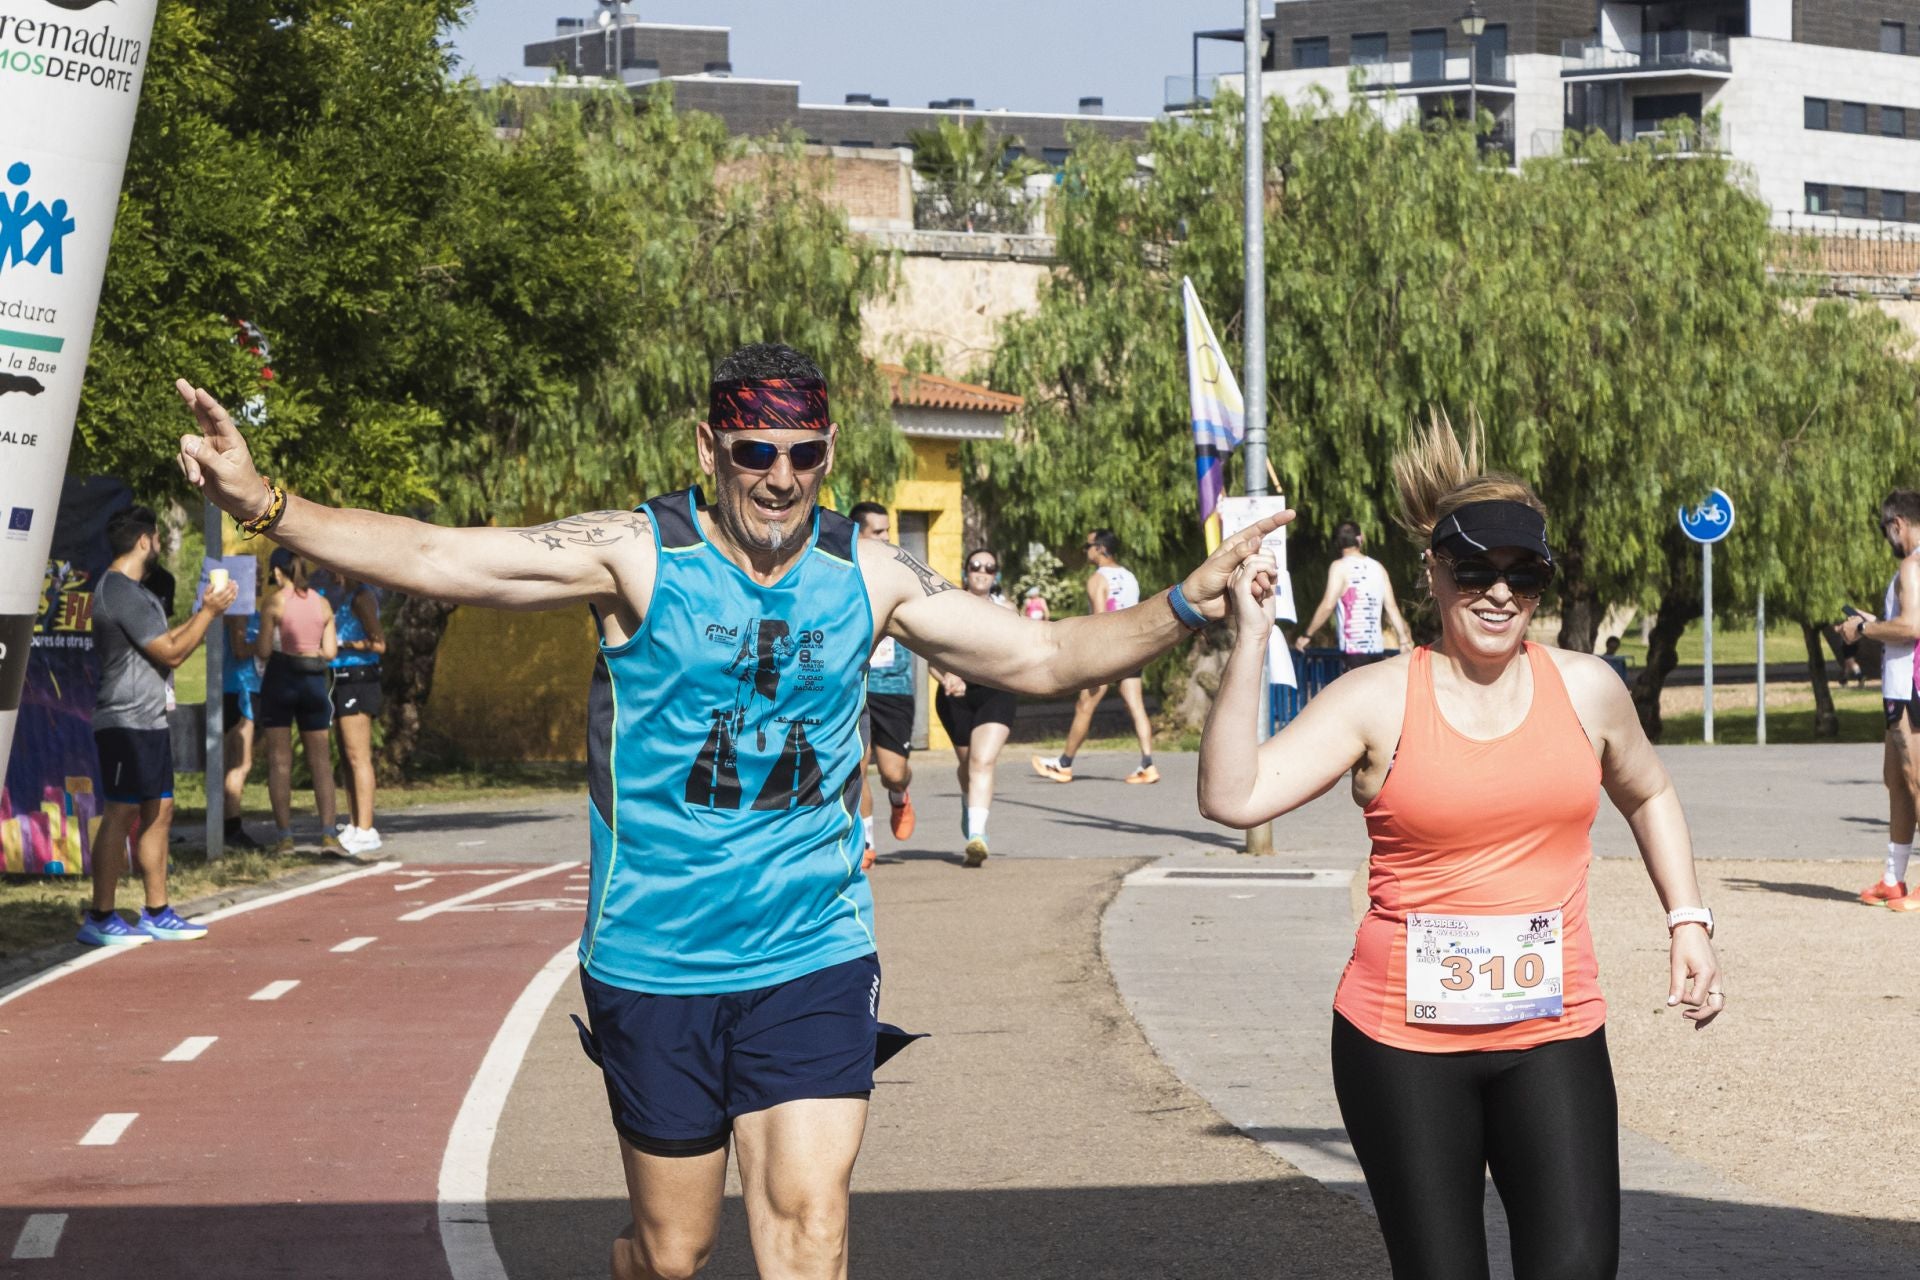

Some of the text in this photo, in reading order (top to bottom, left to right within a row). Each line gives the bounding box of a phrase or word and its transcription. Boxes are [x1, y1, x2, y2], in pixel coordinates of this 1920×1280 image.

[8, 352, 57, 374] la Base
[21, 433, 38, 446] DE
[799, 630, 824, 644] 30
[799, 649, 811, 663] 8
[1454, 946, 1492, 955] aqualia
[1440, 953, 1545, 991] 310
[1414, 1004, 1437, 1019] 5K
